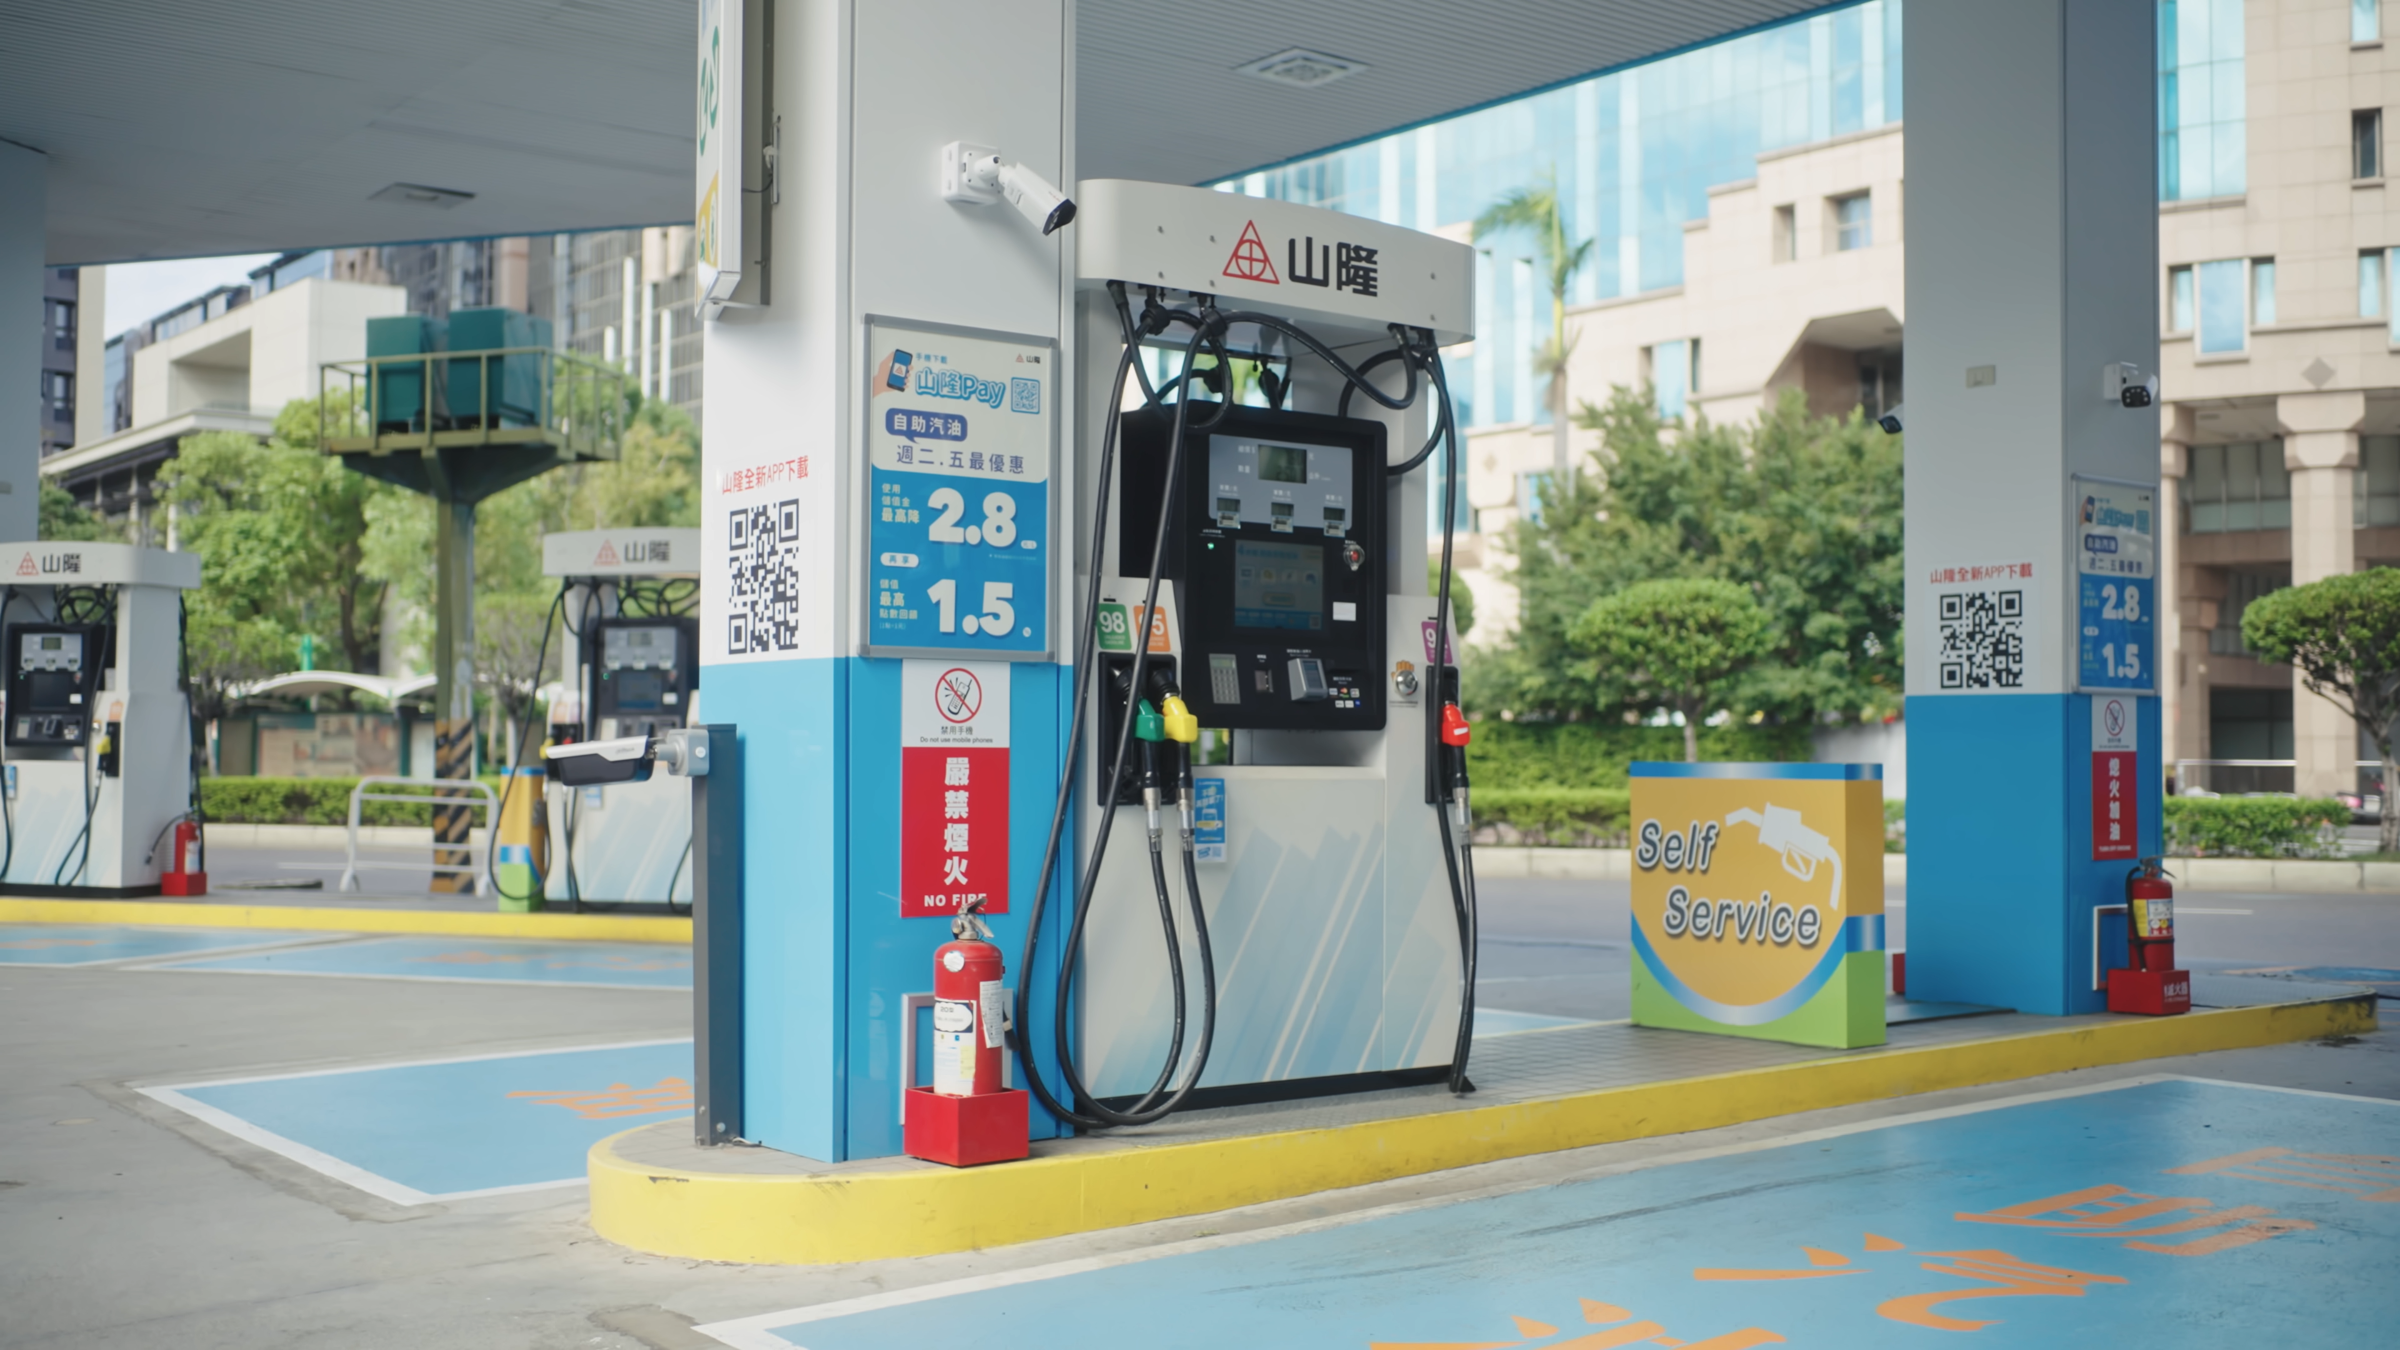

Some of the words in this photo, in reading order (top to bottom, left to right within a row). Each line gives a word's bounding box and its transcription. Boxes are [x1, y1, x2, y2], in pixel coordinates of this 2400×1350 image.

[1288, 236, 1379, 297] 山隆
[916, 367, 1006, 409] 山隆Pay
[893, 413, 962, 436] 自助汽油
[722, 455, 809, 495] 山隆全新APP下載
[881, 507, 920, 524] 最高降
[927, 487, 1017, 548] 2.8
[42, 554, 82, 574] 山隆
[624, 540, 670, 563] 山隆
[1930, 562, 2033, 584] 山隆全新APP下載
[880, 591, 905, 606] 最高
[926, 579, 1015, 636] 1.5
[2102, 584, 2140, 622] 2.8
[1100, 611, 1125, 634] 98
[2102, 642, 2140, 680] 1.5
[941, 726, 974, 736] 禁用手機
[944, 757, 970, 886] 嚴禁煙火
[1636, 818, 1720, 871] Self
[924, 894, 946, 907] NO
[1663, 885, 1821, 946] Service
